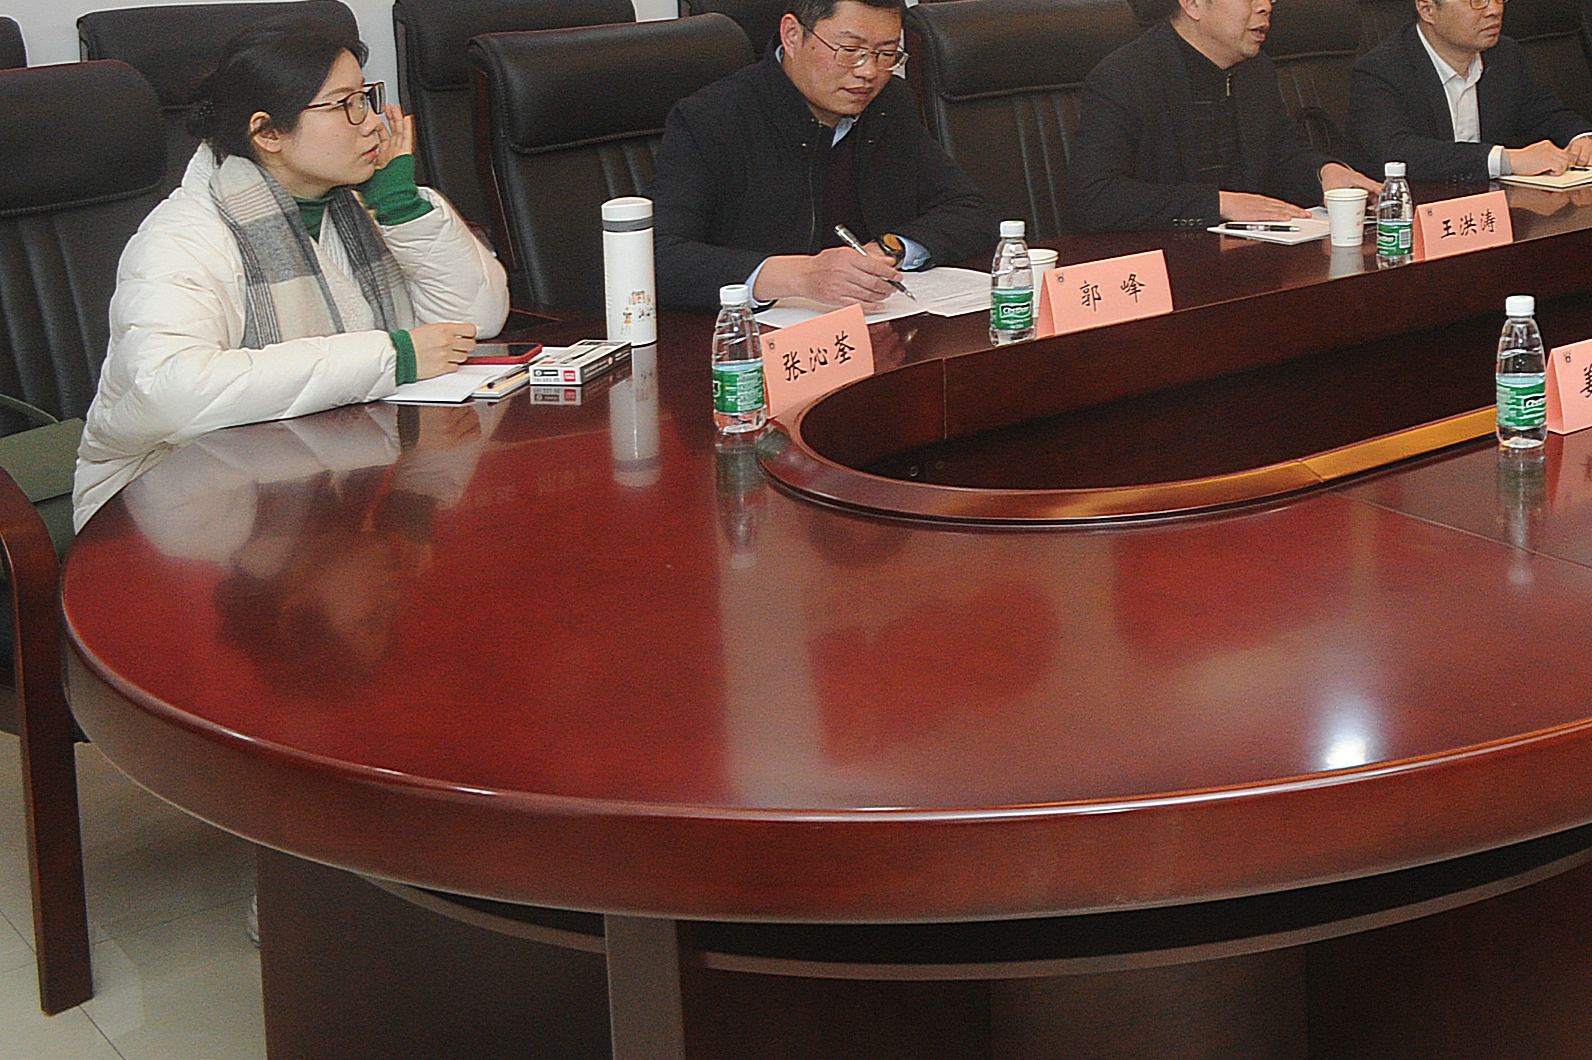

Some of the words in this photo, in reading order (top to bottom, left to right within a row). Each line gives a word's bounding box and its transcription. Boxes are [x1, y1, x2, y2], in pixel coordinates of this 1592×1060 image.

[1441, 208, 1497, 240] 王洪涛
[782, 330, 856, 382] 张沁荃
